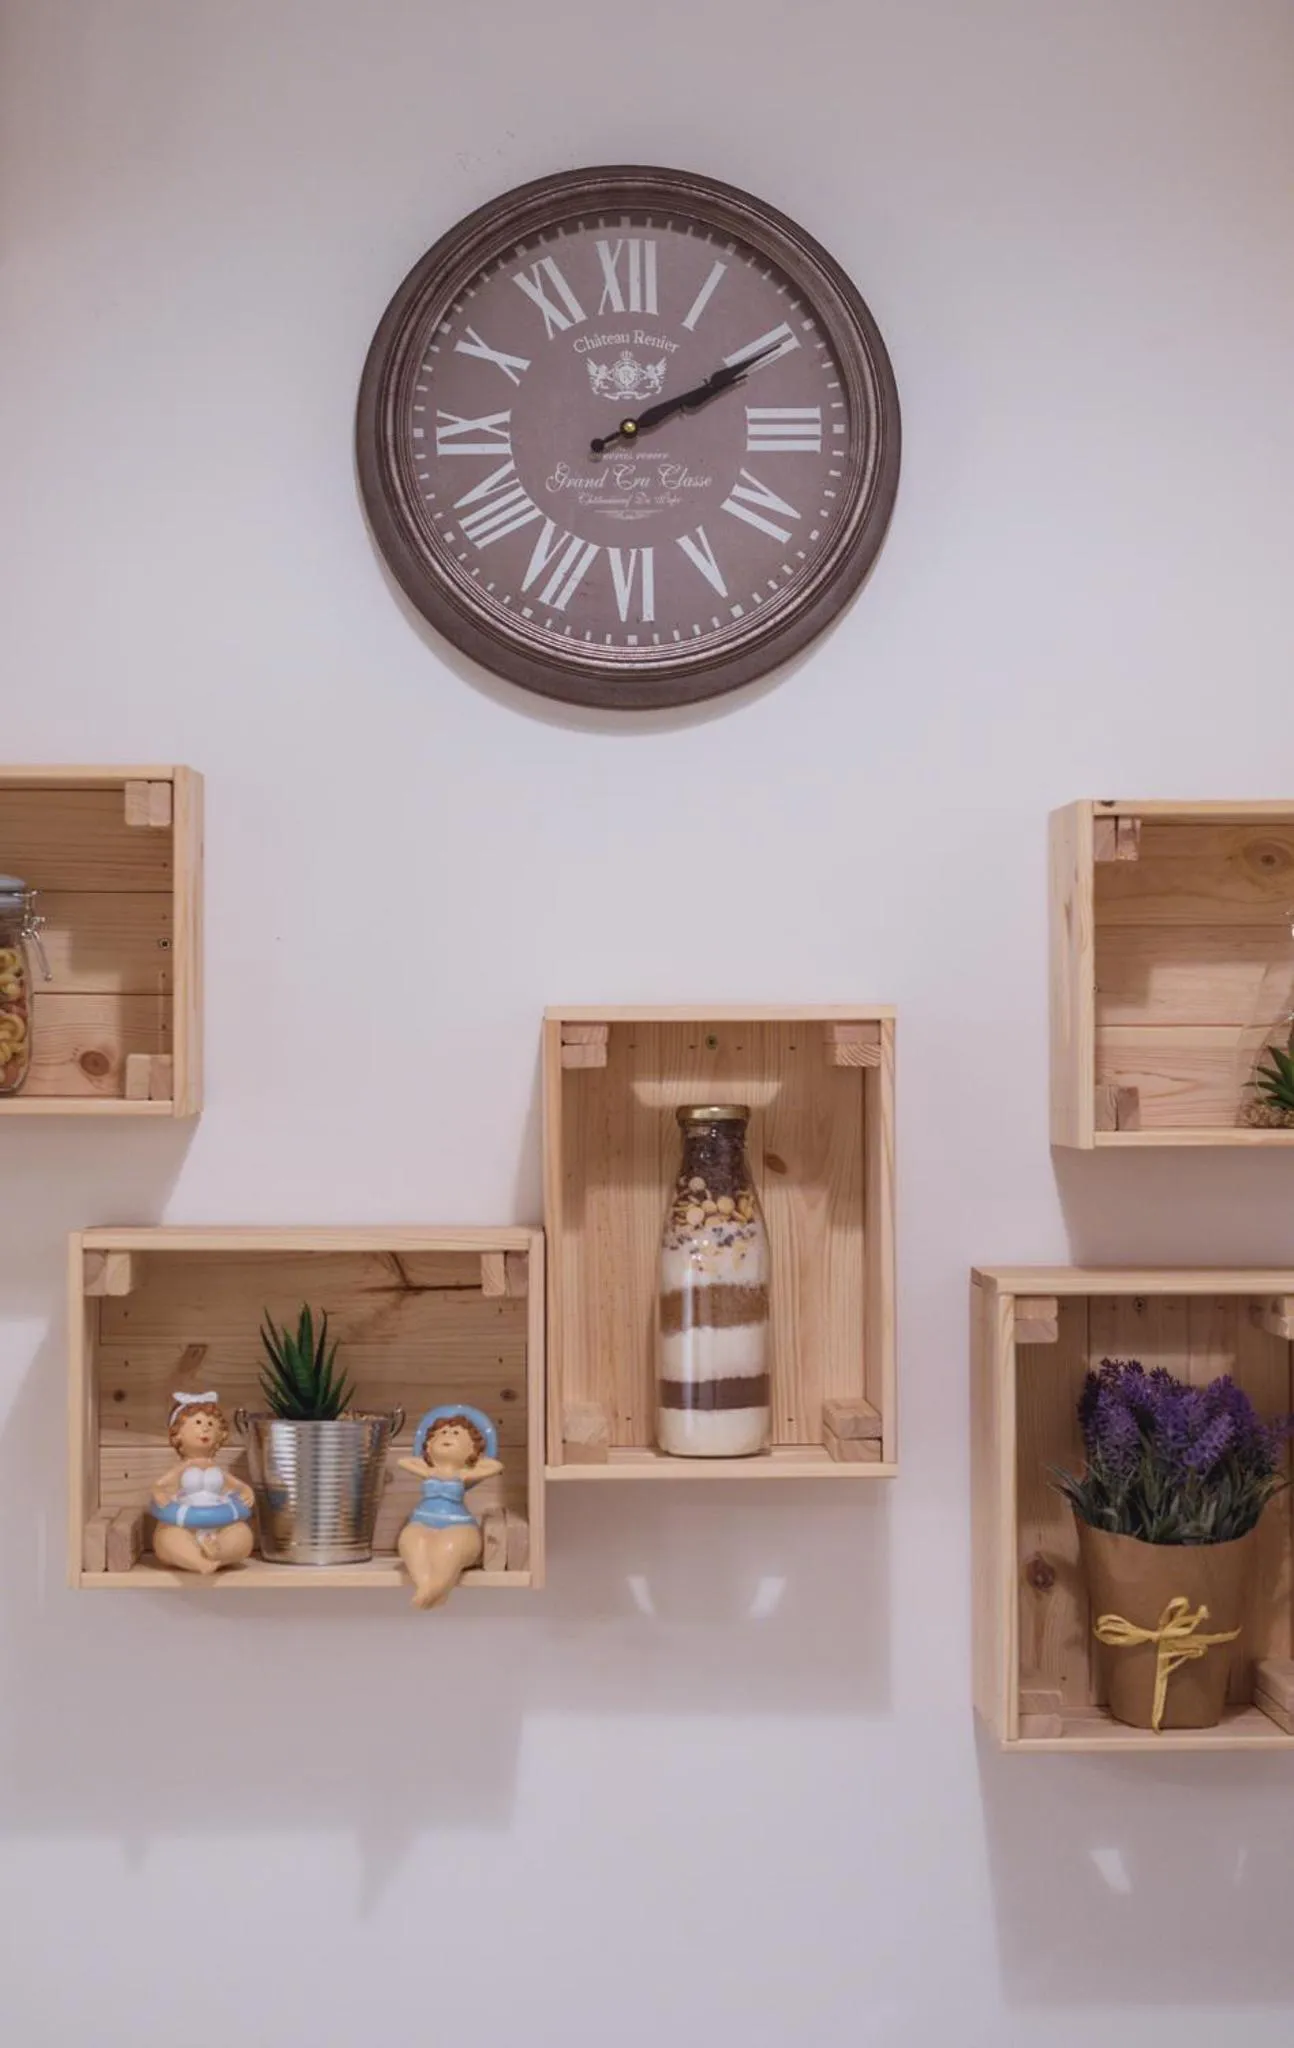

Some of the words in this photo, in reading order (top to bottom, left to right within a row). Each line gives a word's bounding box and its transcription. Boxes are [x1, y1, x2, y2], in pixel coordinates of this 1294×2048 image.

[512, 256, 587, 340] XI
[596, 240, 658, 315] XII
[682, 261, 727, 331] I
[454, 326, 531, 385] X
[633, 330, 680, 353] Renier
[722, 322, 802, 378] II
[436, 410, 512, 455] IX
[745, 406, 821, 452] III
[453, 459, 542, 550] VIII
[546, 462, 609, 492] Grand
[614, 463, 650, 490] Cru
[720, 467, 801, 544] IV
[520, 518, 600, 611] VII
[607, 546, 655, 623] VI
[676, 525, 728, 598] V
